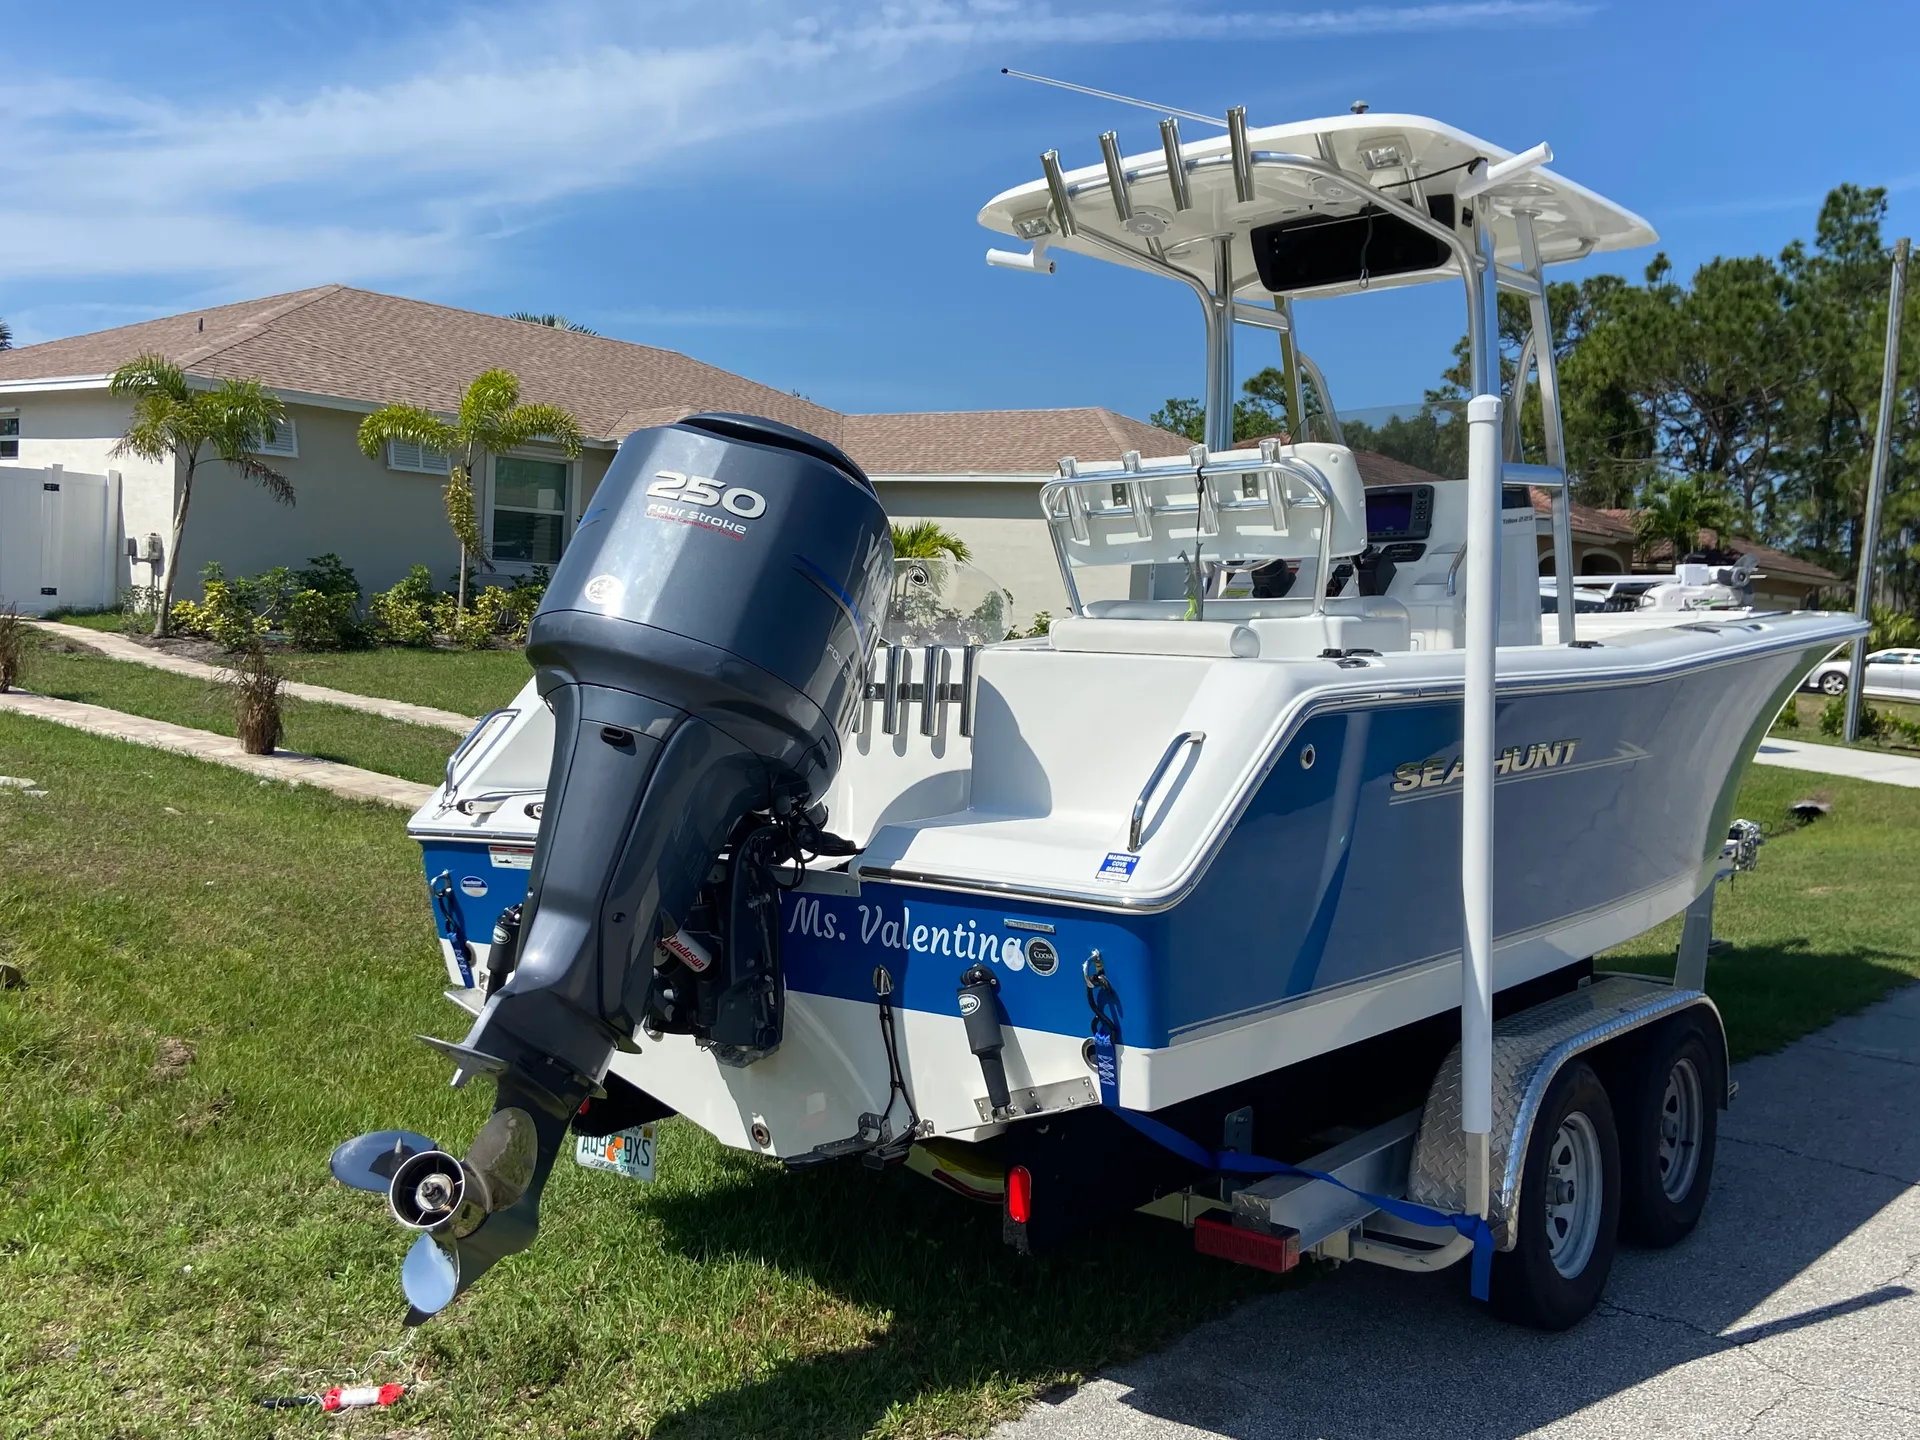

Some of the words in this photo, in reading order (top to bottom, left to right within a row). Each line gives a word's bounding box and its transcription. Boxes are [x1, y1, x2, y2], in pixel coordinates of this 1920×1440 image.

[646, 470, 767, 519] 250
[1391, 757, 1464, 792] SEA
[1494, 738, 1581, 775] HUNT
[1111, 860, 1128, 868] COVE
[788, 897, 846, 940] Ms.
[624, 1136, 651, 1167] 9XS
